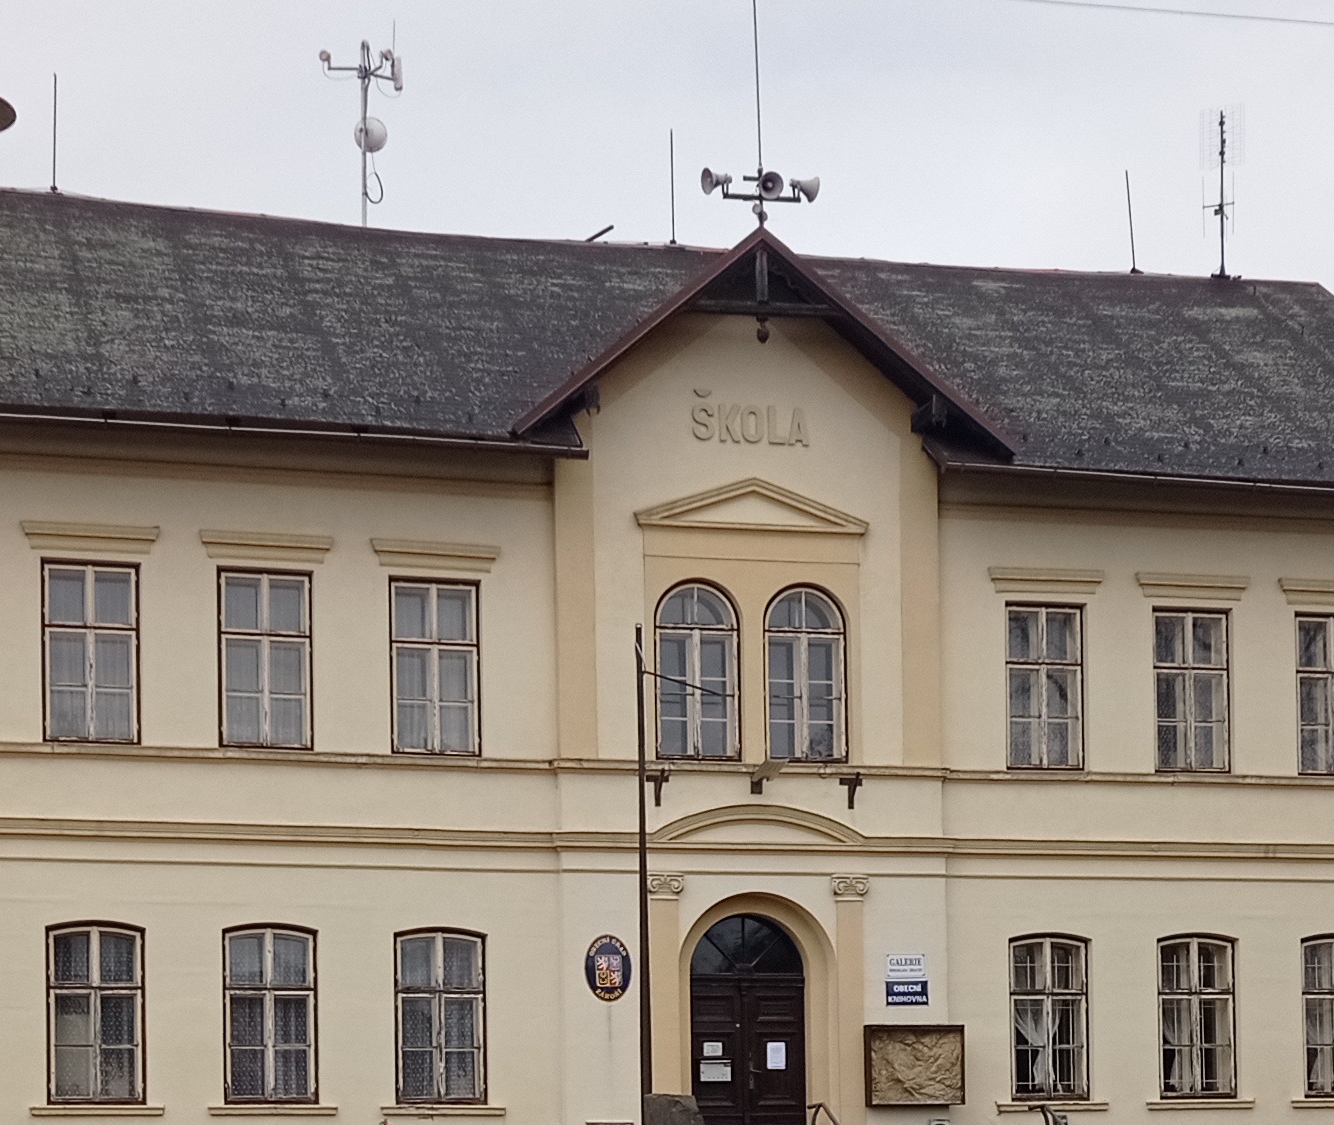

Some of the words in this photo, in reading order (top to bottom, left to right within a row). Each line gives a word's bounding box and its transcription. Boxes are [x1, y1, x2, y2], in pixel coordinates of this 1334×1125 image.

[692, 388, 809, 447] ŠKOLA
[889, 958, 922, 966] GALERIE
[893, 984, 922, 992] OBECNÍ
[888, 995, 927, 1003] KNIHOVNA
